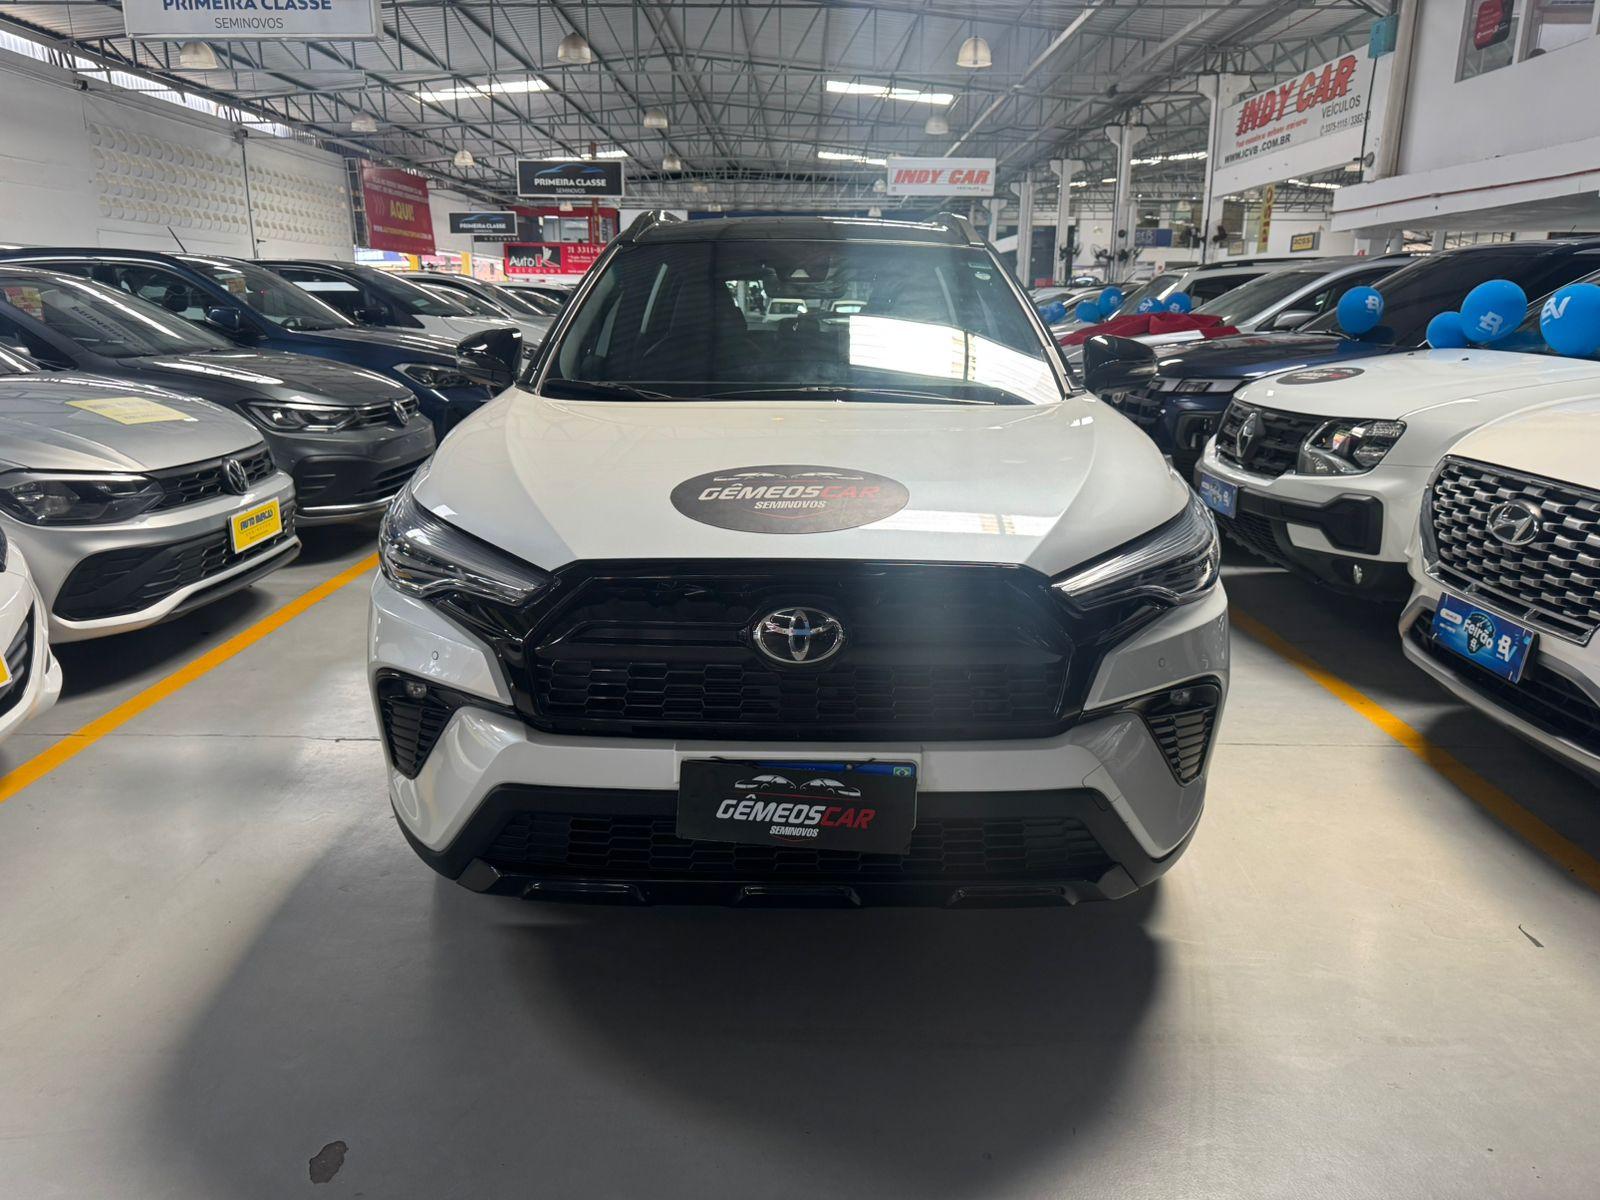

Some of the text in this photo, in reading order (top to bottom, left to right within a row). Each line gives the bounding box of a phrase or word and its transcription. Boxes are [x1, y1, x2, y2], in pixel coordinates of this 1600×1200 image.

[163, 0, 332, 11] PRIMEIRA CLASSE
[214, 17, 284, 29] SEMINOVOS
[1236, 79, 1297, 136] INDY
[1296, 54, 1358, 113] CAR
[1321, 94, 1362, 119] VEÍCULOS
[534, 178, 607, 187] PRIMEIRA CLASSE
[894, 169, 990, 184] INDY CAR
[754, 500, 827, 509] SEMINOVOS
[1463, 618, 1493, 649] Feirão
[769, 825, 819, 837] SEMINOVOS
